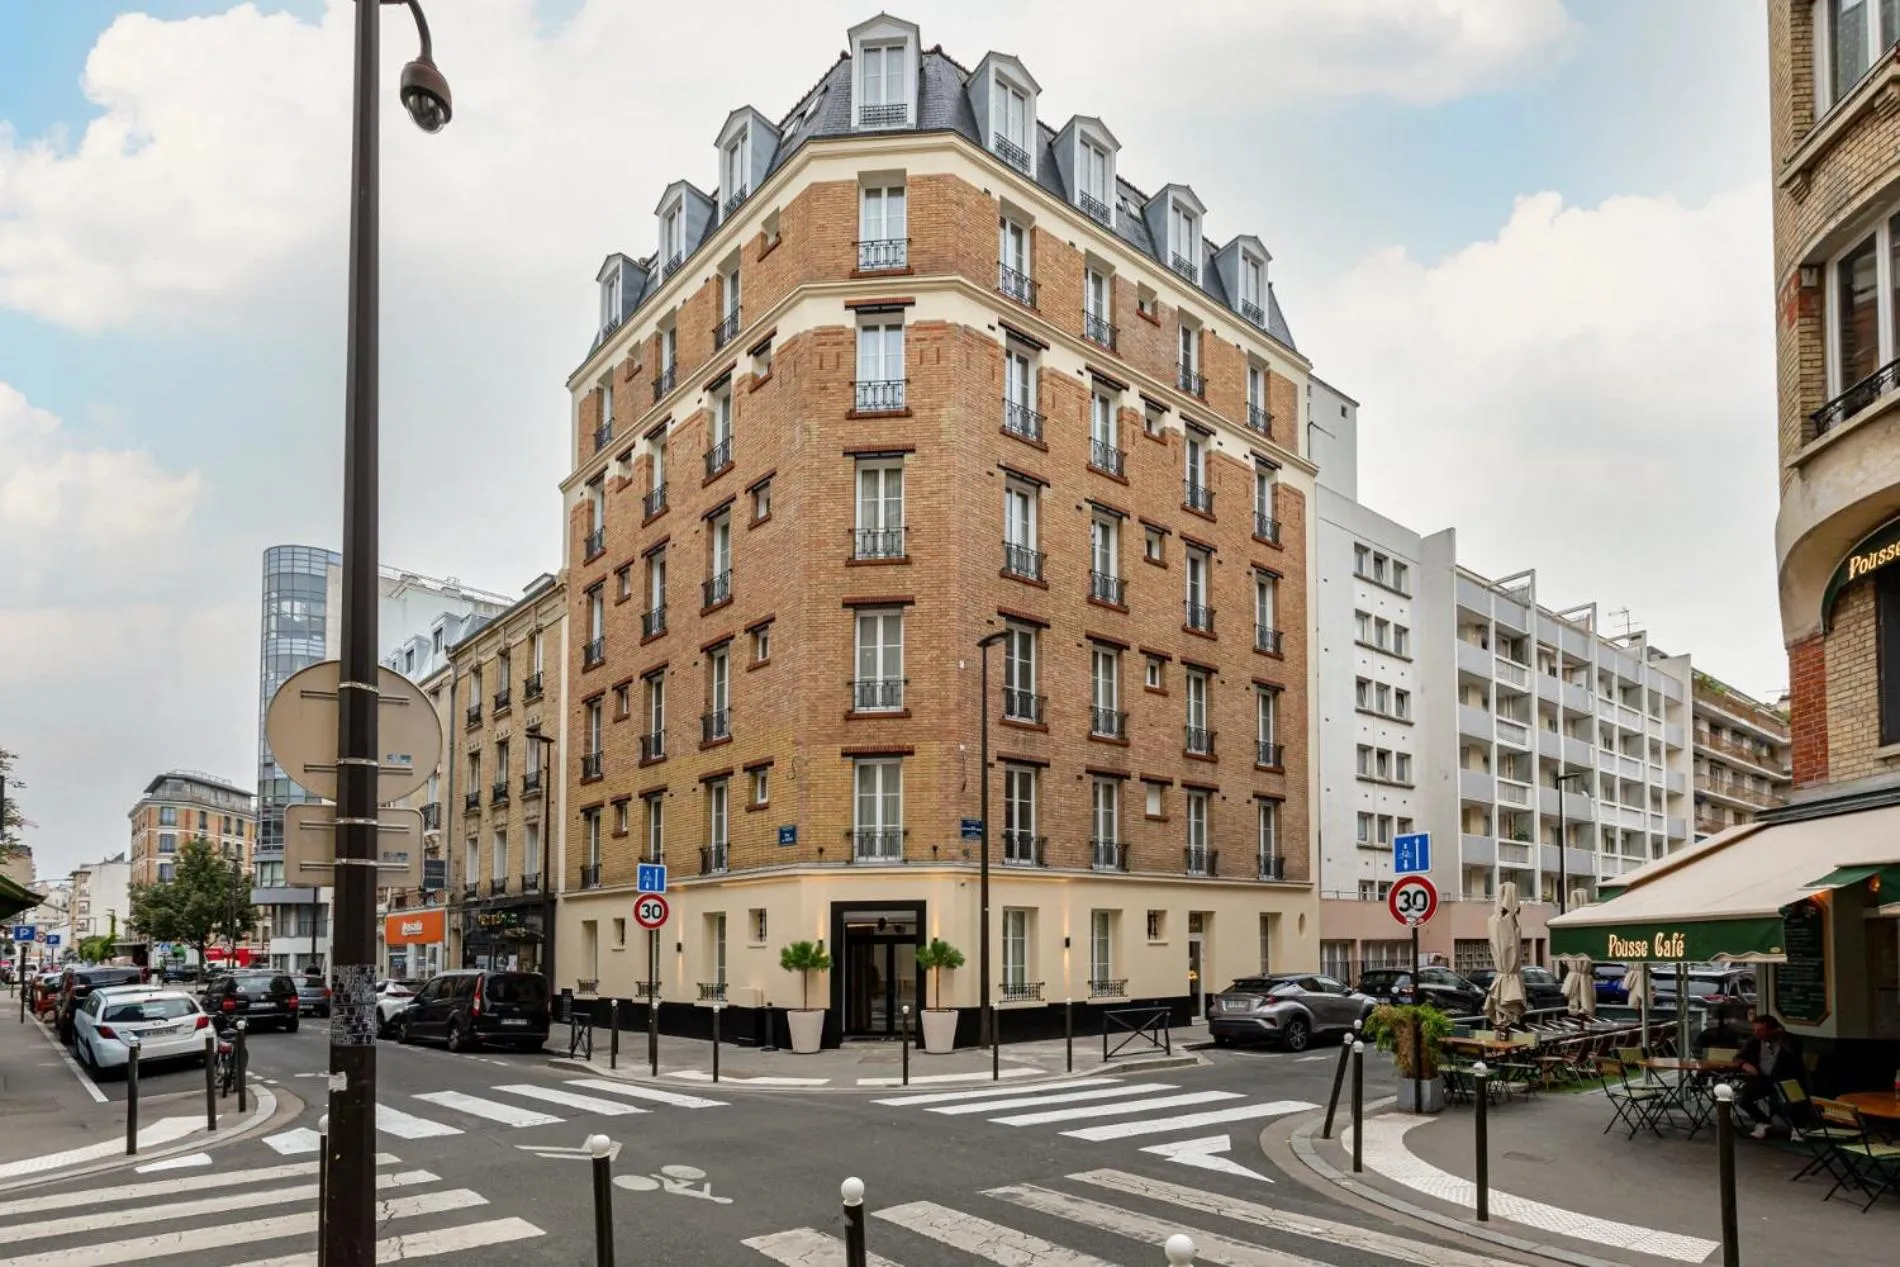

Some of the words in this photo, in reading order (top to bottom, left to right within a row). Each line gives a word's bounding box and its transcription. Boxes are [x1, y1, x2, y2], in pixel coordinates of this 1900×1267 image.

[1398, 890, 1427, 912] 30
[641, 903, 662, 919] 30
[20, 928, 30, 939] P
[1608, 934, 1648, 958] Pousse
[1655, 931, 1685, 958] Café
